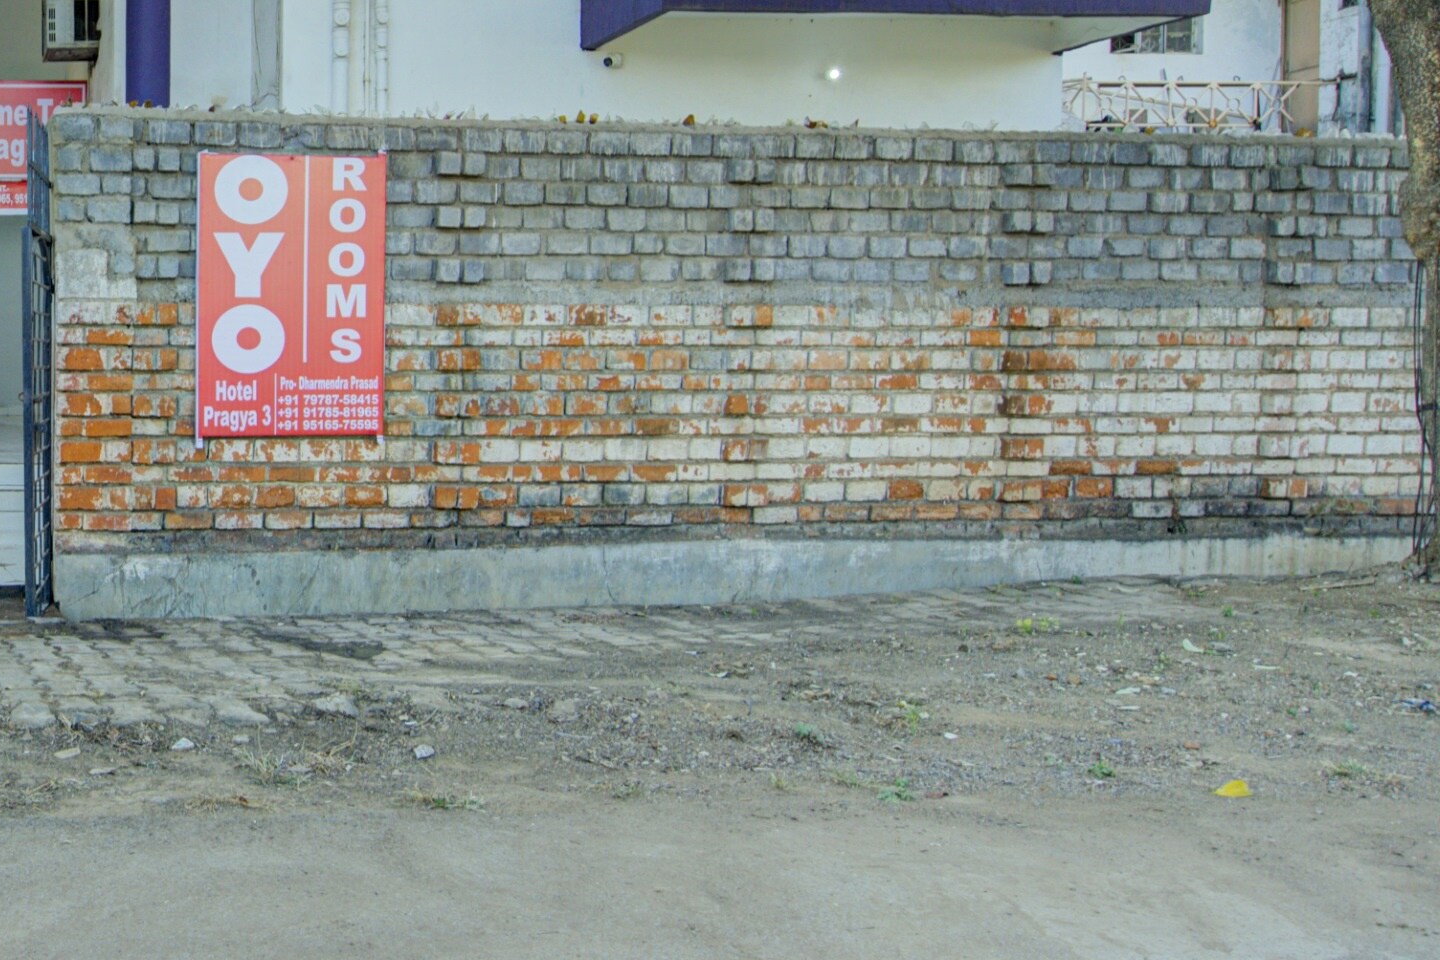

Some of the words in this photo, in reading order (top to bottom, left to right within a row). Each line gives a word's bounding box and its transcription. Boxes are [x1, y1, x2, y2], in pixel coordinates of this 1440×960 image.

[36, 98, 60, 126] T
[211, 154, 289, 374] OYO
[326, 157, 367, 363] ROOMS
[215, 380, 257, 401] Hotel
[280, 376, 296, 390] Pro-
[299, 376, 348, 390] Dharmendra
[351, 375, 378, 390] Prasad
[278, 394, 298, 405] +91
[303, 394, 378, 405] 79787-58415
[203, 405, 257, 432] Pragya
[262, 404, 271, 426] 3
[278, 407, 298, 418] +91
[303, 407, 378, 418] 91785-81965
[278, 420, 298, 431] +91
[303, 420, 378, 431] 95165-75595
